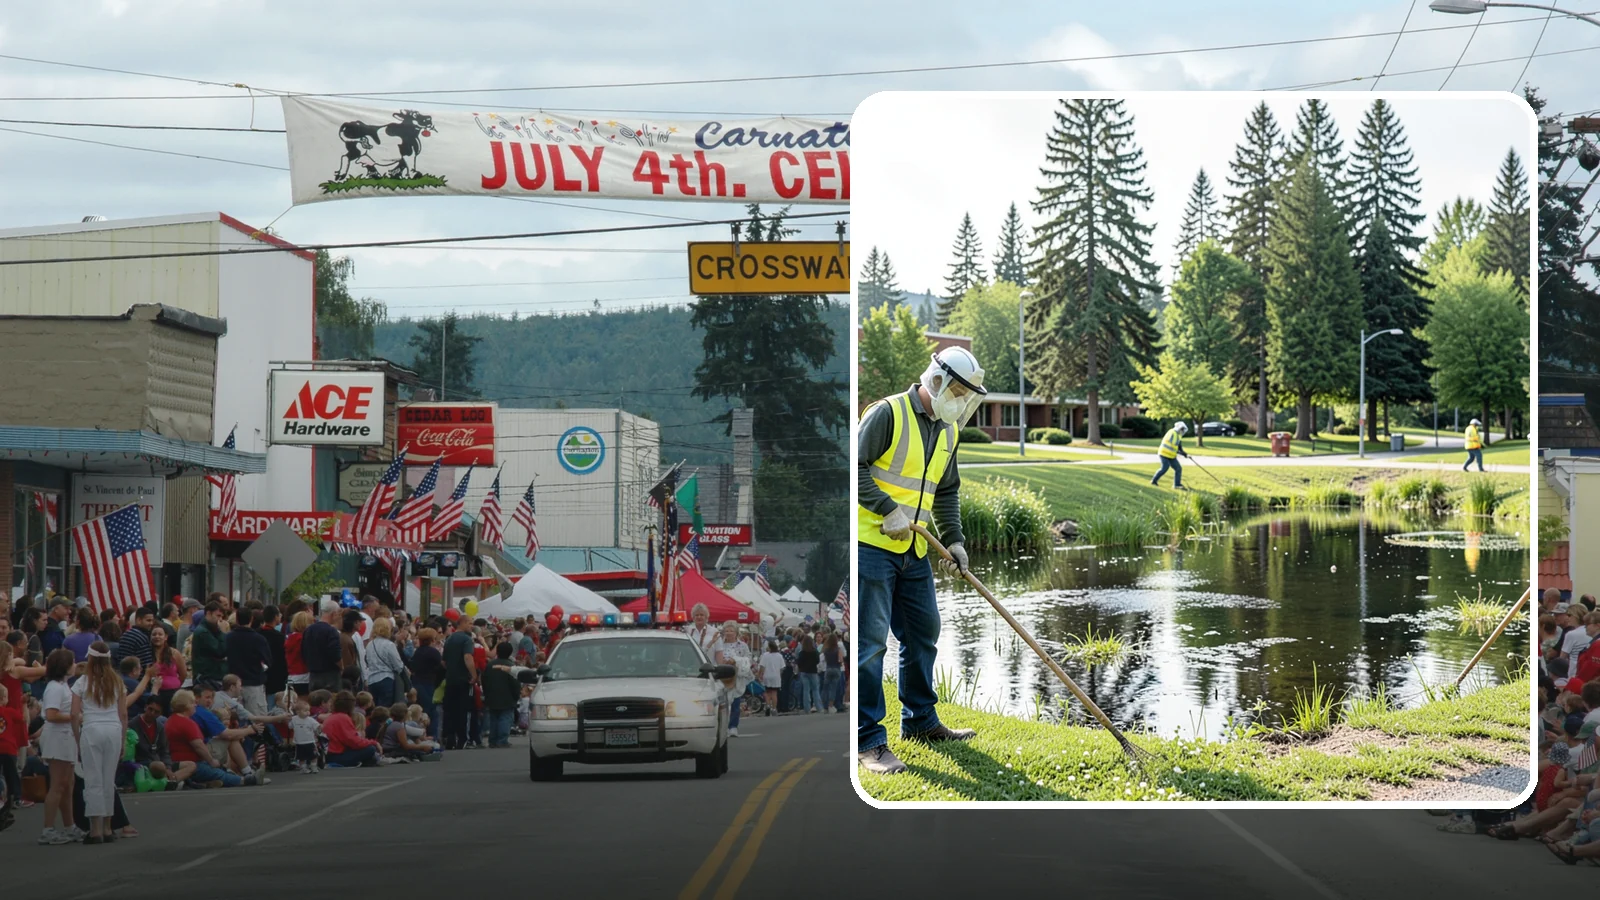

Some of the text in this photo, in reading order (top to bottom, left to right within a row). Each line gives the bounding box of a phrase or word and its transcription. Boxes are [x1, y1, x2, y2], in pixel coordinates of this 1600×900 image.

[481, 141, 605, 193] JULY
[632, 150, 746, 198] 4th.
[697, 254, 850, 280] CROSSWA
[283, 380, 374, 420] ACE
[406, 409, 452, 421] CEDAR
[283, 421, 371, 436] Hardware
[416, 428, 477, 447] Coca-Cola
[353, 466, 386, 479] Simpl
[83, 485, 155, 495] St. Vincent de Paul
[80, 503, 154, 522] THT
[212, 515, 330, 536] HARDARE
[688, 526, 741, 535] CRNATION
[699, 535, 730, 544] GLASS
